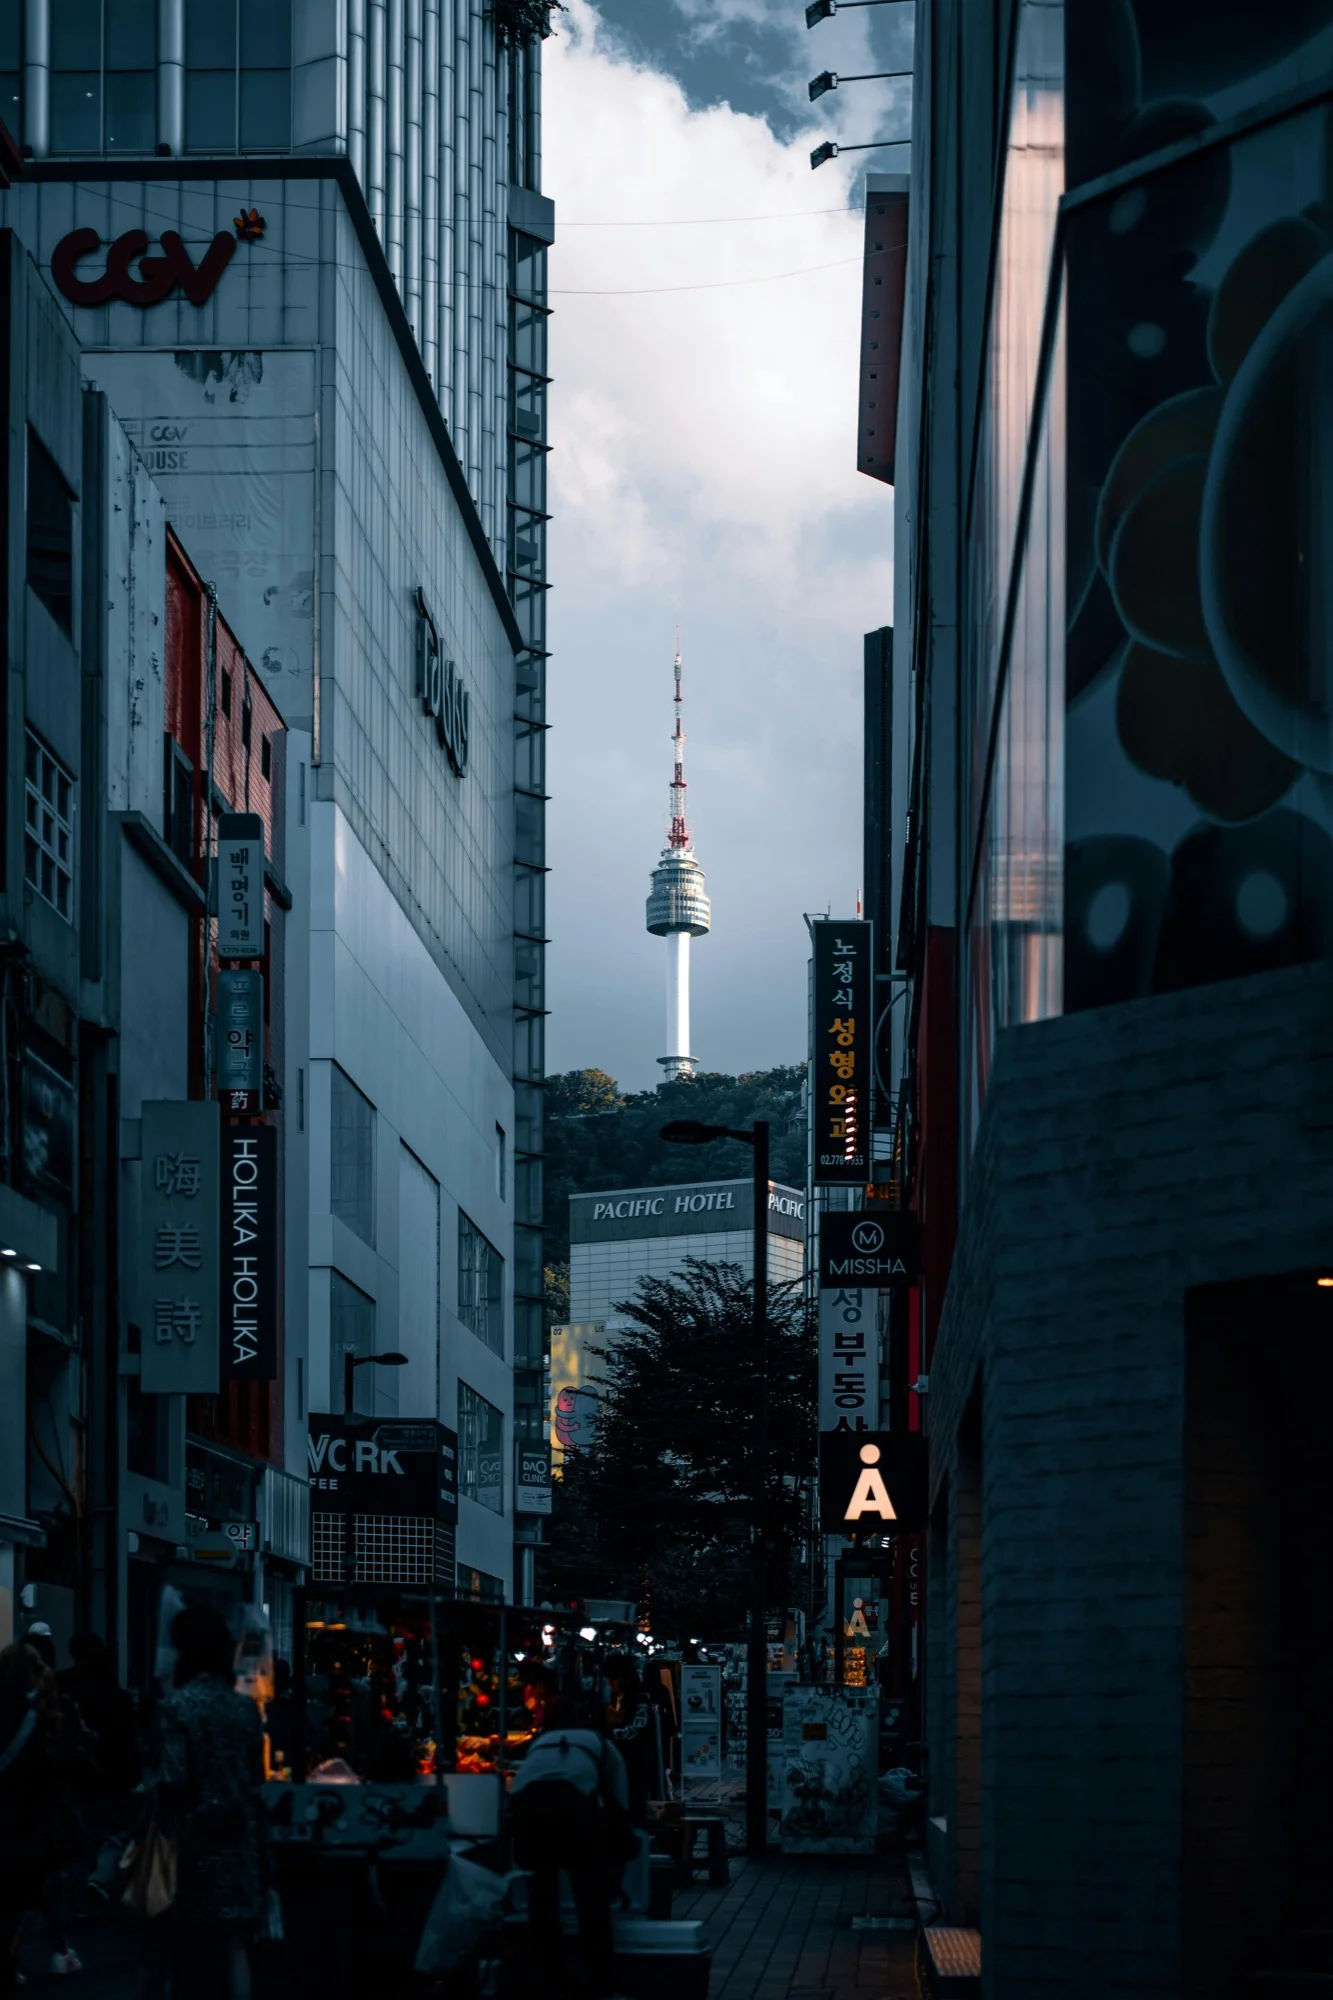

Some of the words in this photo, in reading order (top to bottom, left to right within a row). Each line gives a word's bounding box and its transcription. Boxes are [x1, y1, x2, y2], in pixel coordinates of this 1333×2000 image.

[50, 227, 235, 306] CGV
[150, 425, 188, 441] CGV
[143, 451, 188, 470] OUSE
[229, 847, 249, 927] 백명기
[230, 930, 250, 941] 의원
[832, 938, 858, 1011] 노정식
[230, 1091, 249, 1109] 药
[232, 1138, 259, 1247] HOLIKA
[592, 1198, 665, 1220] PACIFIC
[674, 1192, 736, 1213] HOTEL
[767, 1193, 805, 1219] PACIFIC
[829, 1258, 907, 1275] MISSHA
[232, 1256, 259, 1364] HOLIKA
[553, 1328, 563, 1336] 02
[522, 1460, 548, 1475] DAO
[522, 1473, 547, 1484] CLINIC
[227, 1524, 251, 1549] 약
